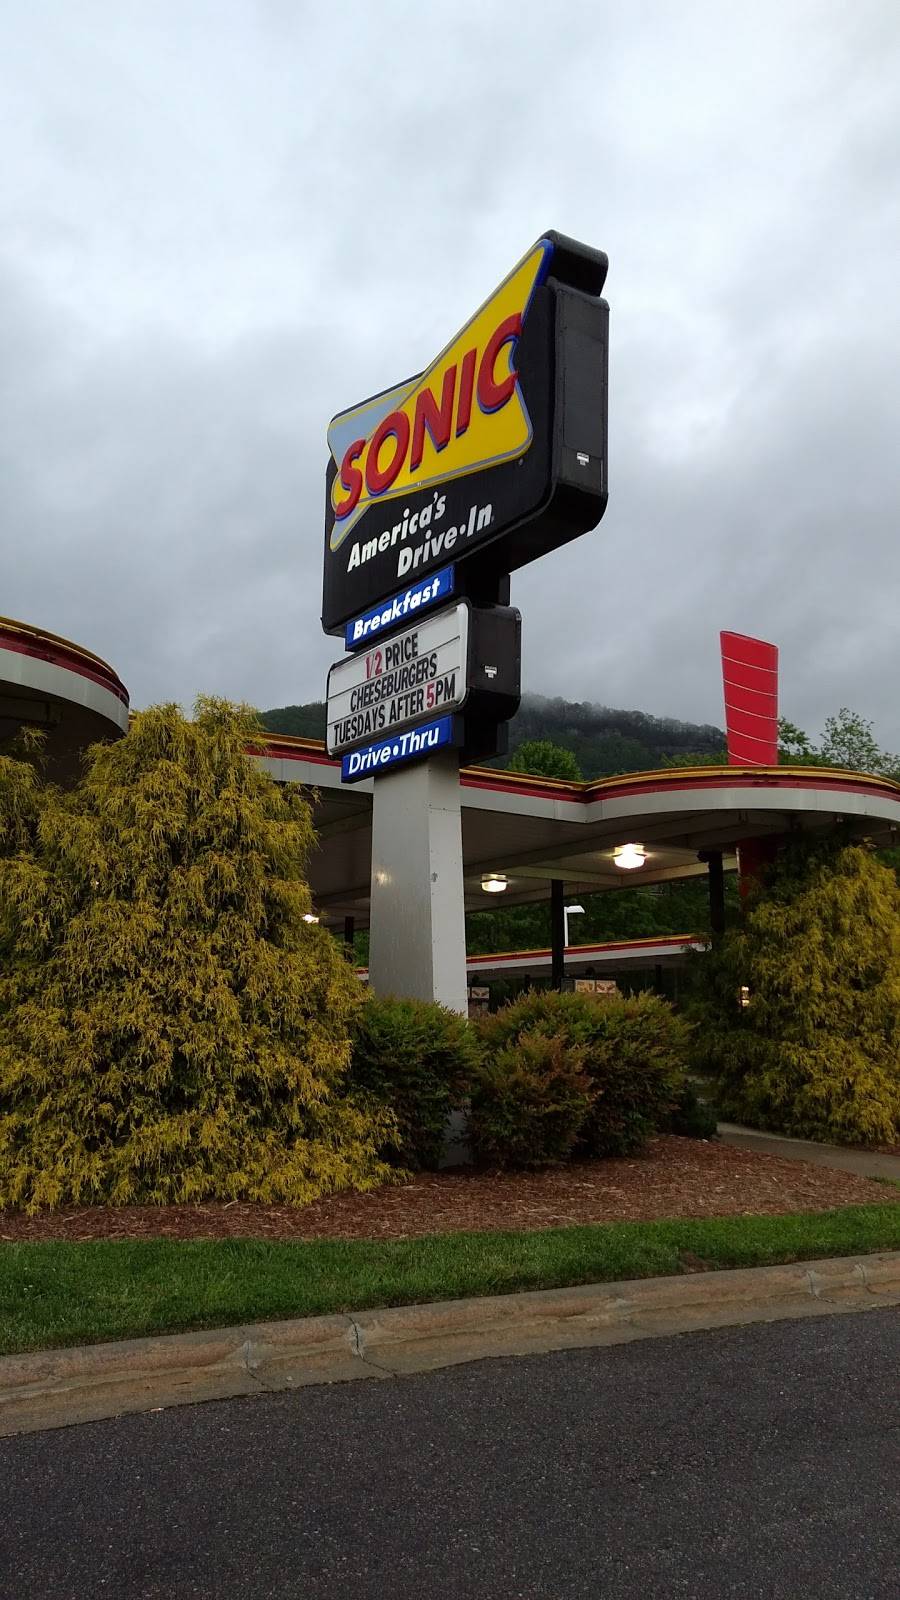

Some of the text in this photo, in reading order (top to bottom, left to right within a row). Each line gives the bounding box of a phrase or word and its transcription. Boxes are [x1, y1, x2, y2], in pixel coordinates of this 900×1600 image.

[335, 312, 522, 519] SONIC
[347, 492, 447, 572] America's
[353, 577, 441, 641] Breakfast
[350, 654, 438, 712] CHEESEBURGERS
[365, 633, 419, 680] 1/2 PRICE
[334, 674, 456, 746] TUESDAYS AFTER 5PM
